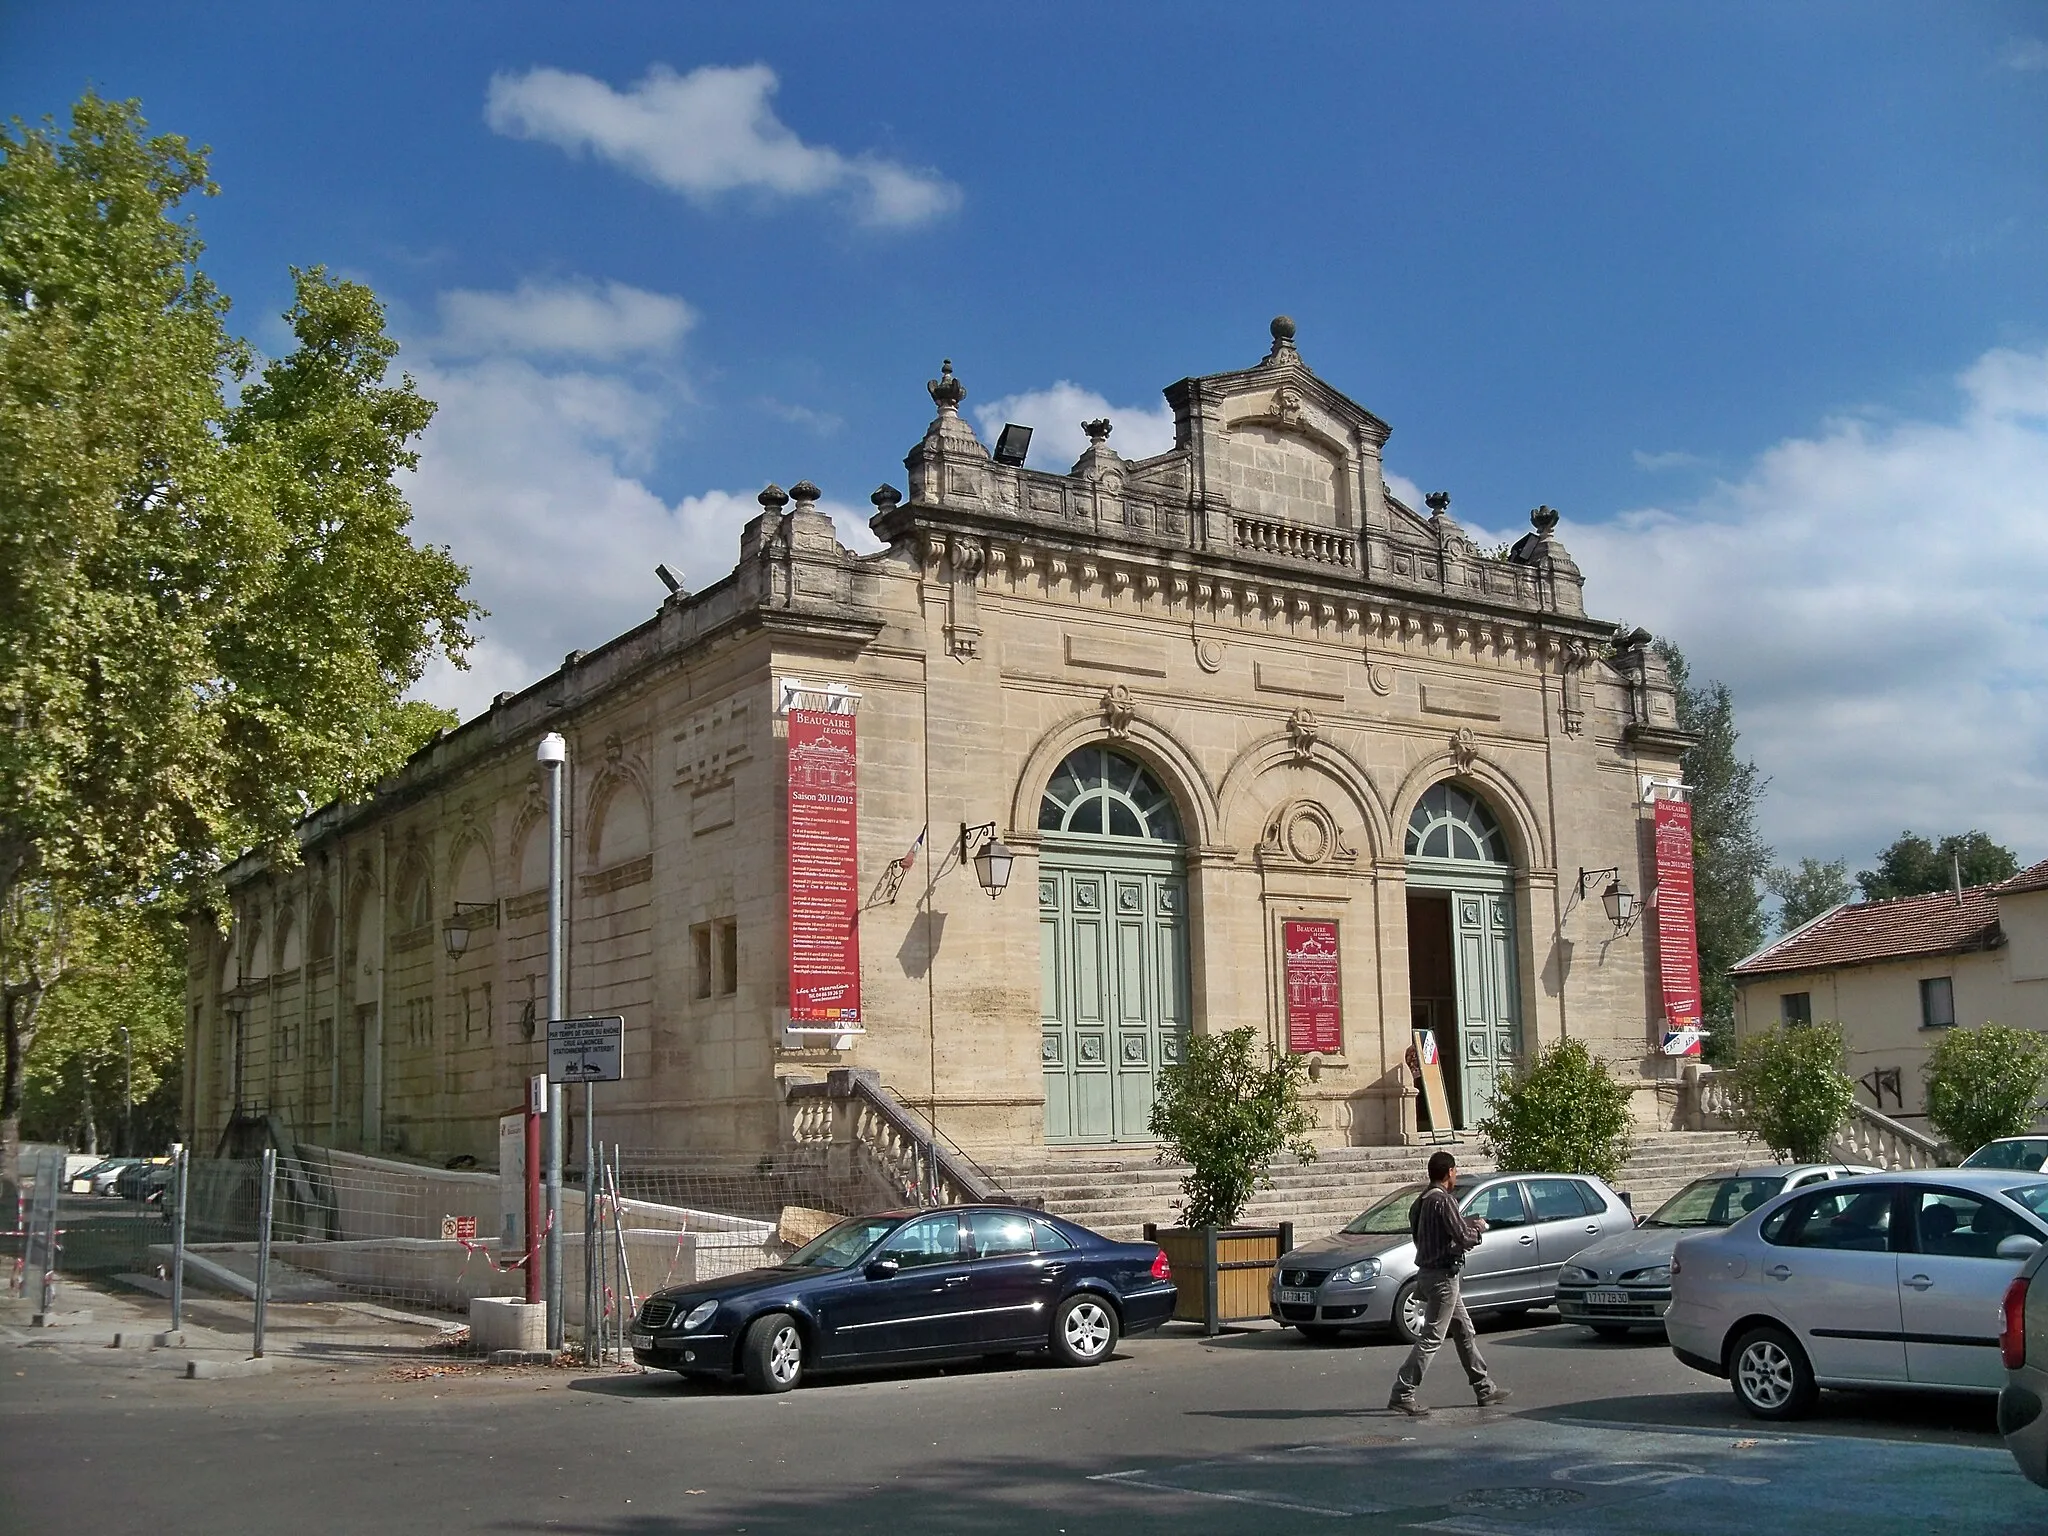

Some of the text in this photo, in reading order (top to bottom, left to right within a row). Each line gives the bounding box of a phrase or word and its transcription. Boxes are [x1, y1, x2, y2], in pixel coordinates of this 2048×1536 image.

[797, 713, 850, 728] BEAUCAIRE
[830, 728, 852, 736] CASINO
[793, 792, 853, 804] Saison 2011/2012
[1658, 802, 1687, 813] BEAUCAIRE
[1658, 859, 1671, 867] Saison
[553, 1046, 592, 1055] STATIONNEMENT
[1665, 1037, 1681, 1054] EXPO
[1588, 1293, 1605, 1303] 1717
[1618, 1293, 1627, 1303] 30
